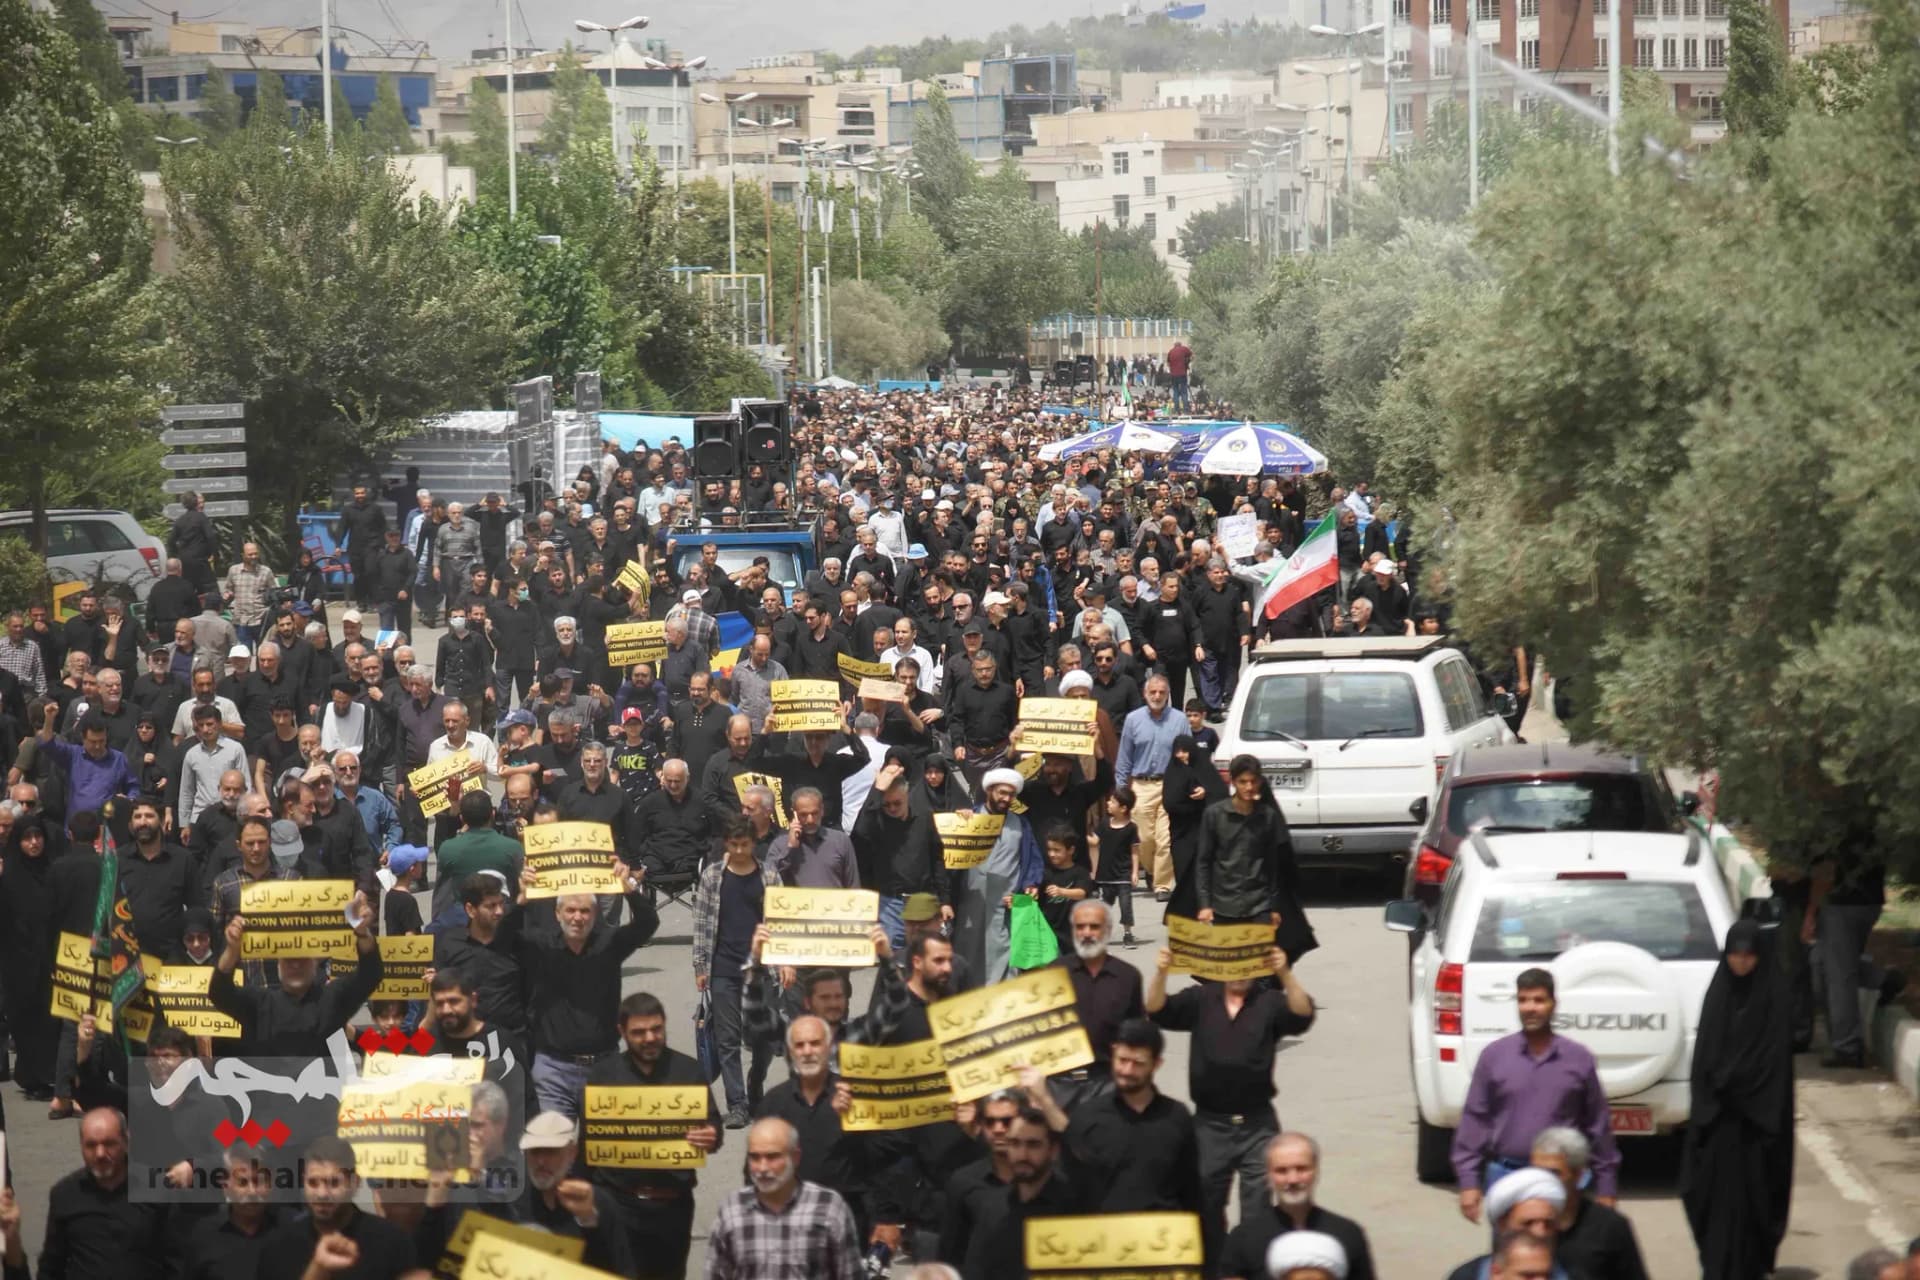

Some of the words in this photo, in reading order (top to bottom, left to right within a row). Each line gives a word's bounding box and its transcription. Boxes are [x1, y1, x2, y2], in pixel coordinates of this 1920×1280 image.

[529, 831, 565, 850] امریکا
[587, 830, 611, 848] مرگ
[528, 855, 559, 868] DOWN
[560, 853, 590, 865] WITH
[582, 873, 618, 889] الموت
[245, 888, 295, 908] اسرائیل
[299, 895, 312, 908] بر
[317, 887, 349, 907] مرگ
[771, 895, 815, 916] امریکا
[840, 895, 873, 917] مرگ
[278, 916, 309, 928] WITH
[807, 922, 840, 934] WITH
[243, 934, 303, 954] لاسرائیل
[307, 934, 352, 953] الموت
[400, 941, 430, 959] مرگ
[384, 948, 396, 960] بر
[56, 969, 91, 989] DOWN
[393, 965, 425, 975] ISRAE
[196, 977, 208, 991] بر
[388, 981, 430, 997] الموت
[177, 996, 204, 1007] WITH
[1026, 982, 1067, 1006] مرگ
[200, 1017, 240, 1033] الموت
[938, 1001, 990, 1033] امریکا
[1551, 1012, 1668, 1032] SUZUKI
[919, 1046, 946, 1067] رگ
[590, 1094, 642, 1116] اسرائیل
[647, 1099, 662, 1117] بر
[666, 1093, 702, 1115] مرگ
[382, 1125, 418, 1137] WITH
[586, 1123, 625, 1135] DOWN
[626, 1124, 658, 1136] WITH
[656, 1147, 705, 1166] الموت
